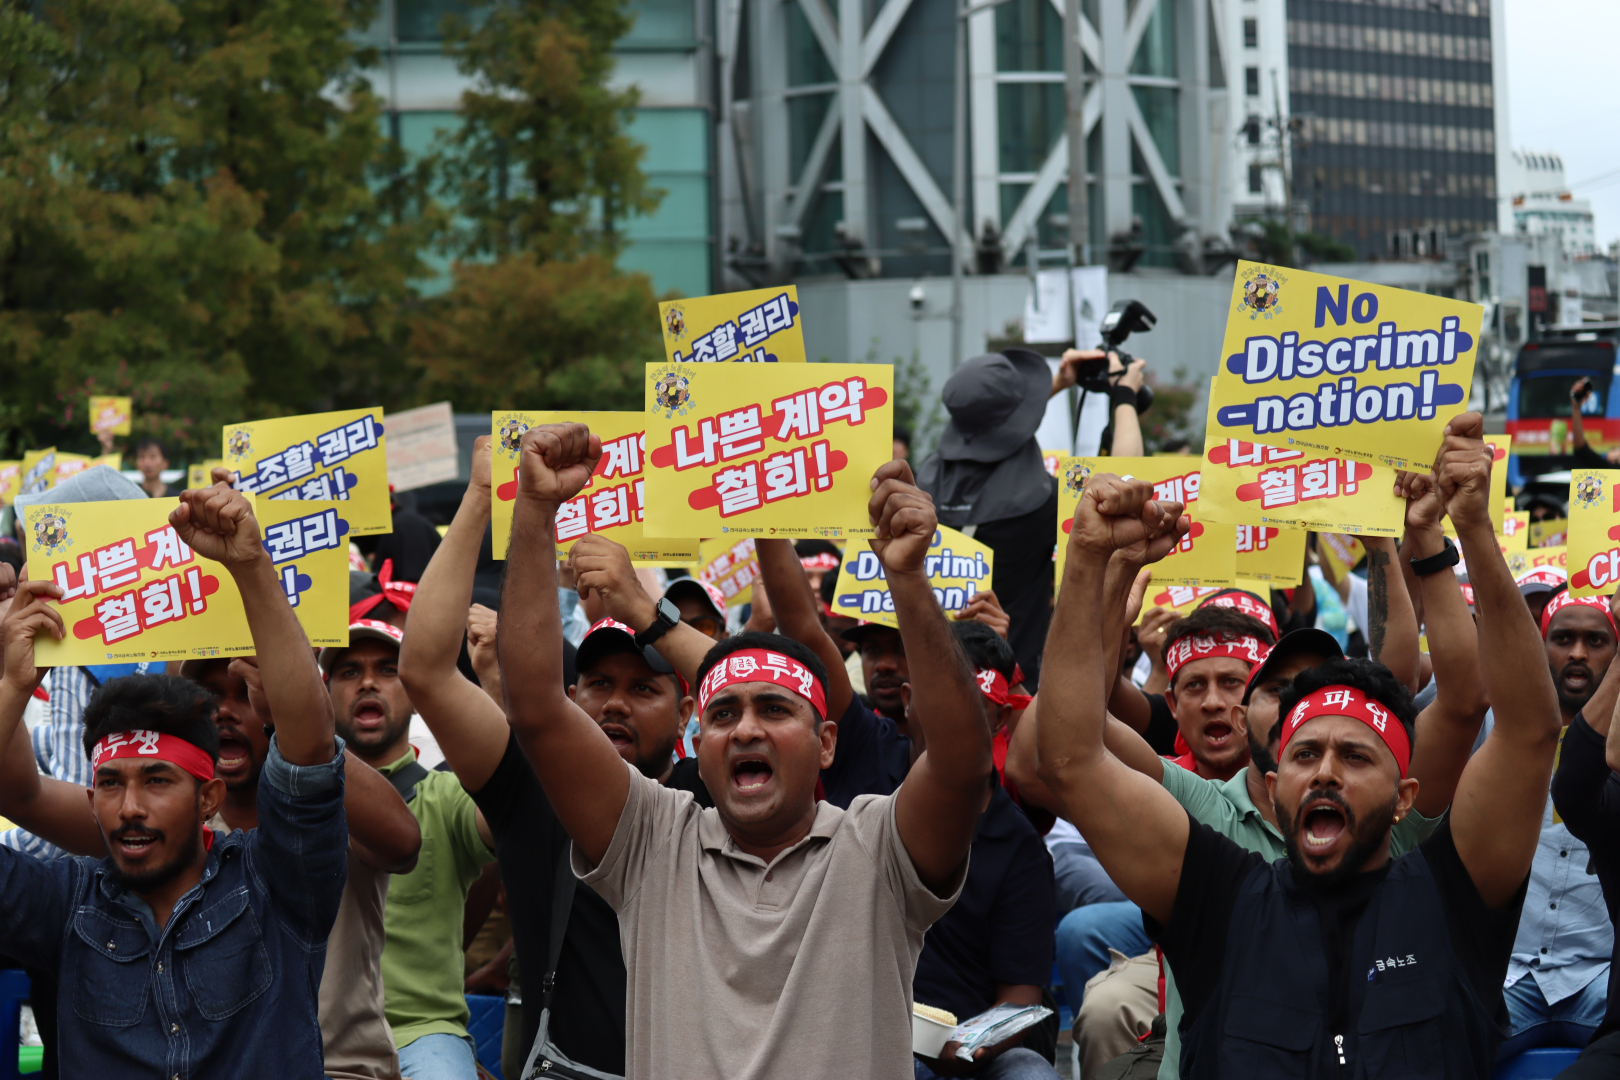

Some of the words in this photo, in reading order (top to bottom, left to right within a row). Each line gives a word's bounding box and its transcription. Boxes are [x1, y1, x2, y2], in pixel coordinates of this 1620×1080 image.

[739, 294, 793, 347] 권리
[1314, 283, 1379, 328] No
[1244, 318, 1458, 381] Discrimi
[673, 407, 764, 469] 나쁜
[774, 380, 865, 439] 계약
[1226, 372, 1438, 432] -nation!
[317, 415, 377, 467] 권리
[714, 442, 830, 516] 철회!
[1259, 459, 1357, 508] 철회!
[266, 510, 338, 563] 권리
[54, 540, 139, 602] 나쁜
[856, 549, 983, 580] Drimi
[96, 568, 206, 643] 철회!
[699, 657, 729, 709] 단결
[761, 652, 814, 699] 투쟁
[1166, 635, 1193, 673] 단결
[103, 729, 161, 758] 투쟁
[1375, 953, 1418, 972] 금속노조
